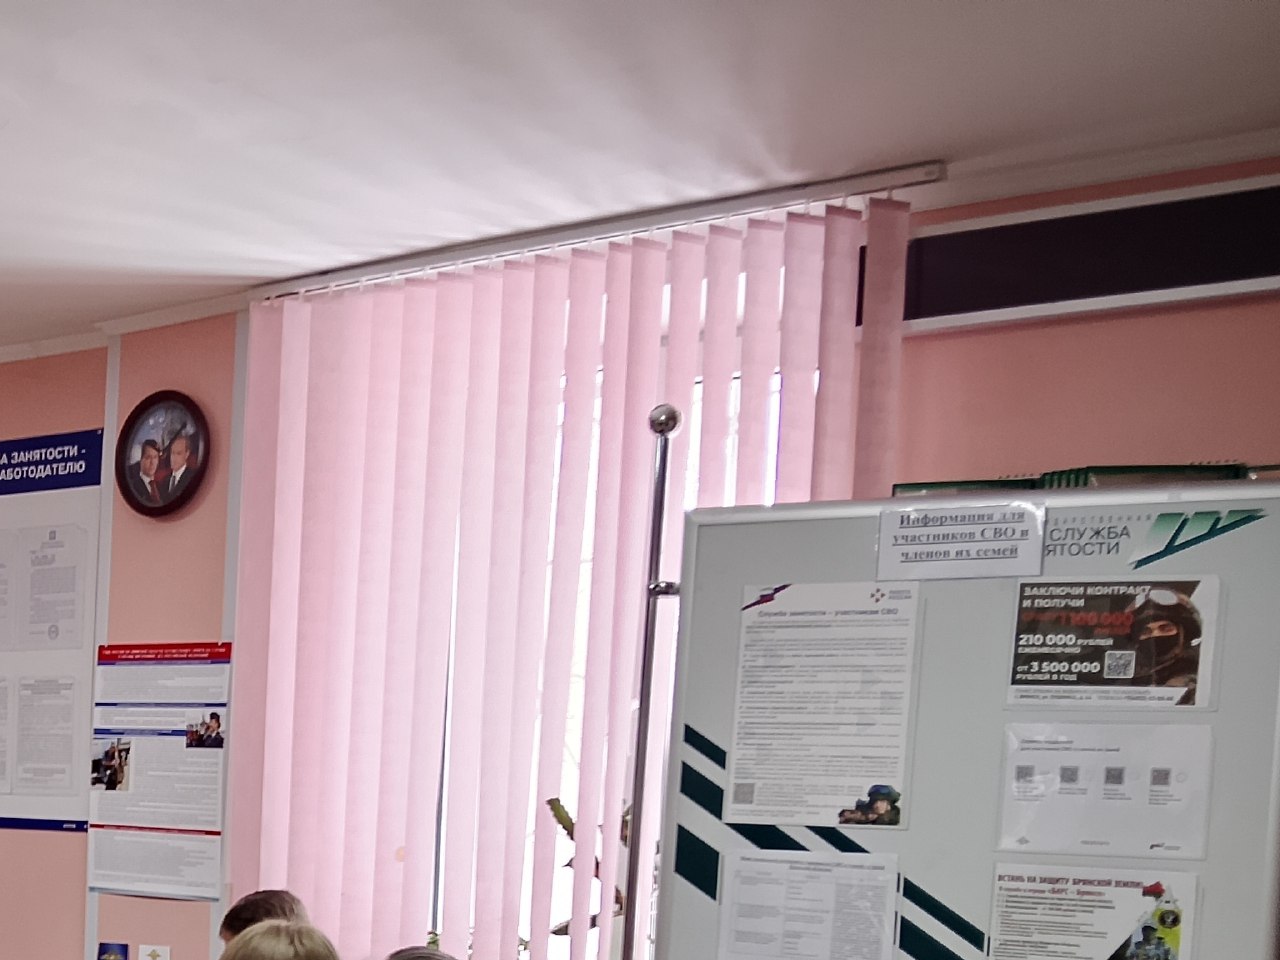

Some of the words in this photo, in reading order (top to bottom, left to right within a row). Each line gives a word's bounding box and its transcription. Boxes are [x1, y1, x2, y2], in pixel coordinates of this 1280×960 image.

[11, 445, 78, 464] ЗАНЯТОСТИ
[999, 511, 1025, 523] для
[892, 531, 976, 545] участников
[980, 526, 1016, 540] СВО
[1020, 528, 1030, 538] и
[1049, 525, 1131, 542] СЛУЖБА
[901, 550, 951, 562] членов
[954, 548, 971, 559] их
[976, 544, 1020, 559] семей
[1023, 586, 1084, 596] ЗАКЛЮЧИ
[1086, 585, 1150, 596] КОНТРАКТ
[1022, 599, 1032, 608] И
[1034, 598, 1085, 608] ПОЛУЧИ
[1018, 633, 1044, 645] 210
[1045, 633, 1076, 645] 000
[1030, 661, 1039, 672] 3
[1041, 661, 1069, 672] 500
[1071, 661, 1100, 673] 000
